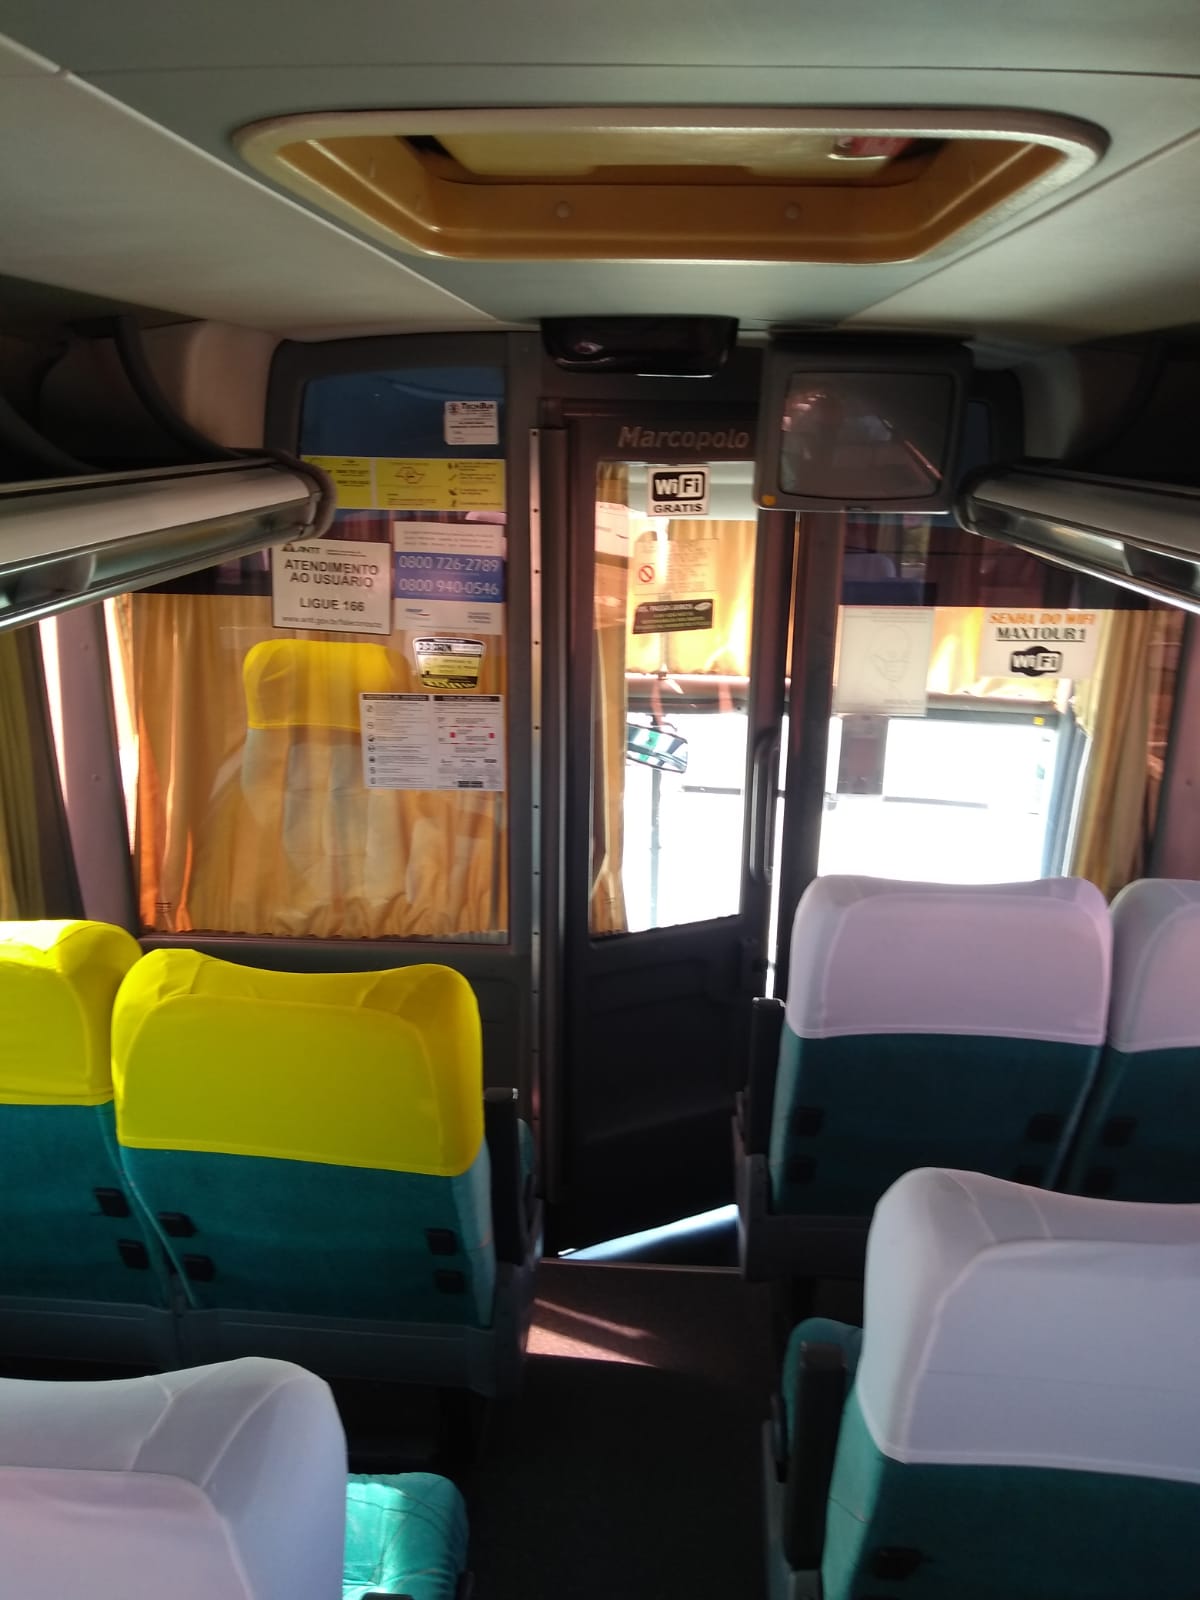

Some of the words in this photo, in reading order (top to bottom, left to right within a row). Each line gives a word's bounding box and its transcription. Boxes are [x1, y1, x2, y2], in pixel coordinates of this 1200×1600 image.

[617, 426, 750, 451] Marcopolo
[655, 478, 700, 495] WiFi
[653, 503, 703, 513] GRATIS
[284, 559, 379, 575] ATENDIMENTO
[399, 556, 433, 569] 0800
[436, 557, 498, 572] 726-2789
[290, 572, 310, 583] AO
[399, 578, 433, 592] 0800
[436, 580, 498, 595] 940-0546
[299, 597, 339, 610] LIGUE
[343, 601, 365, 611] 166
[989, 613, 1034, 624] SENHA
[1040, 614, 1061, 624] DO
